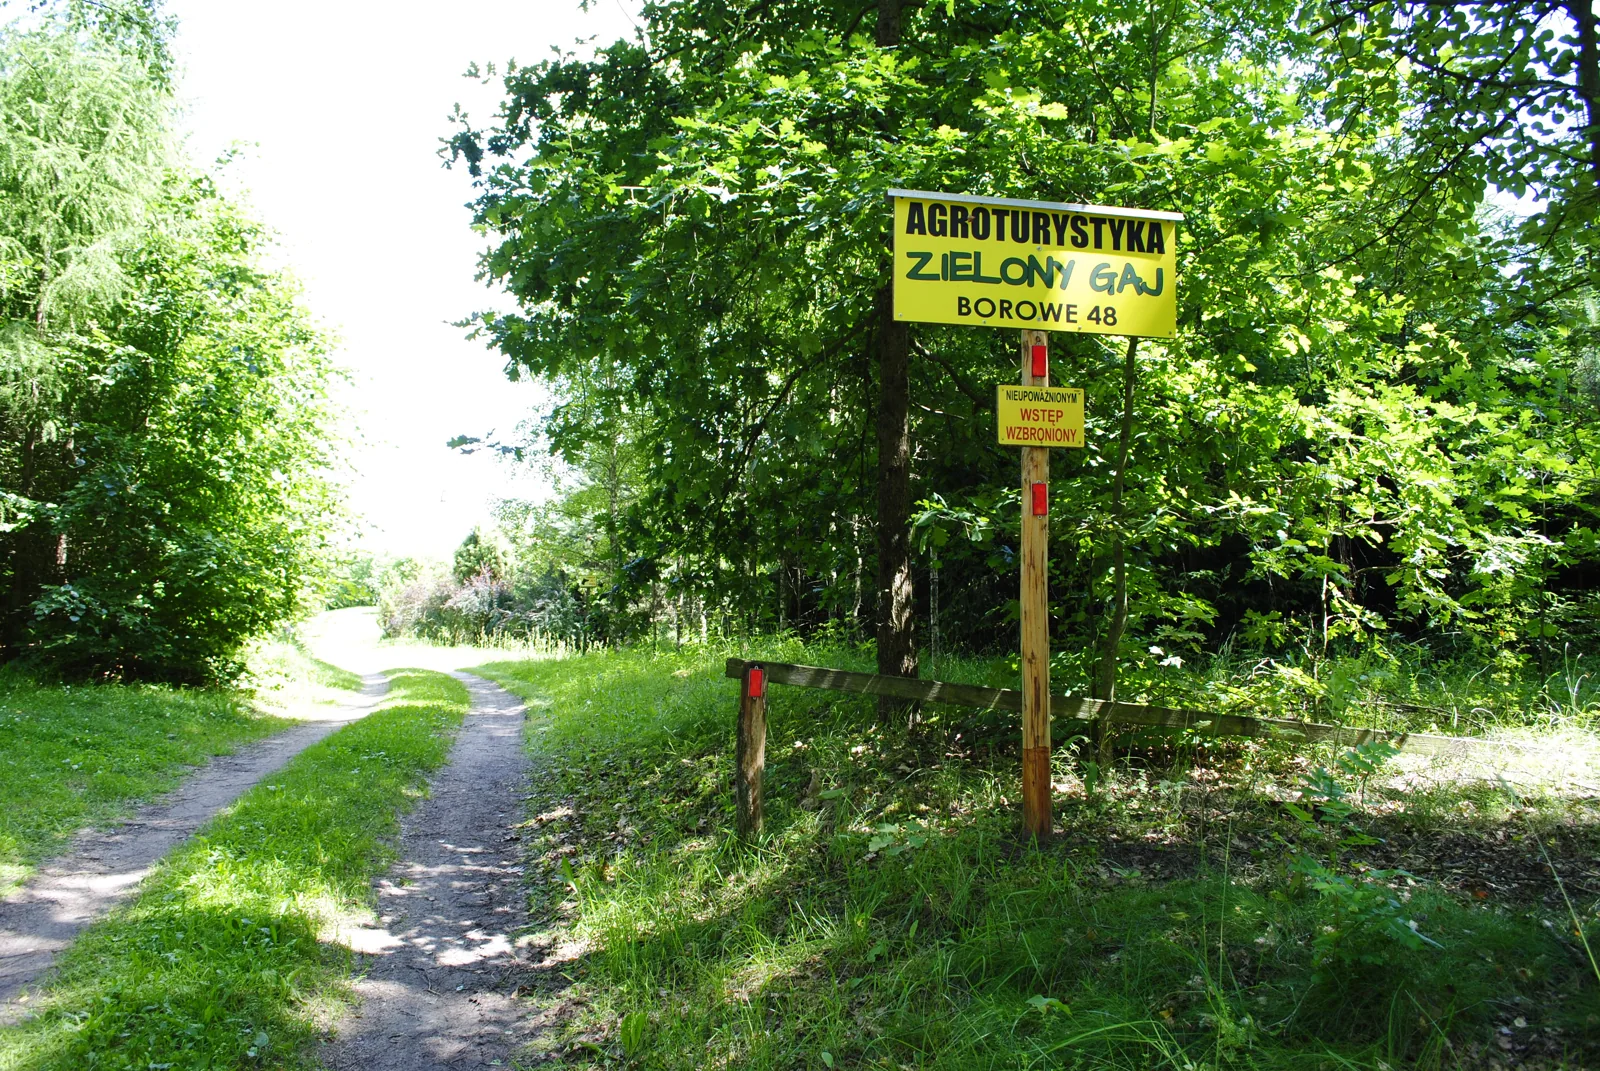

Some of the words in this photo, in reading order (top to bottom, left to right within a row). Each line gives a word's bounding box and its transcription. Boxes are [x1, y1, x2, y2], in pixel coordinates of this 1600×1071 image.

[906, 202, 1165, 254] AGROTURYSTYKA
[906, 251, 1075, 290] ZIELONY
[1089, 262, 1164, 297] GAJ
[957, 296, 1078, 324] BOROWE
[1087, 306, 1118, 326] 48
[1006, 389, 1078, 404] NIEUPOWAŻNIONYM
[1020, 408, 1064, 426] WSTĘP
[1006, 426, 1077, 443] WZBRONIONY
